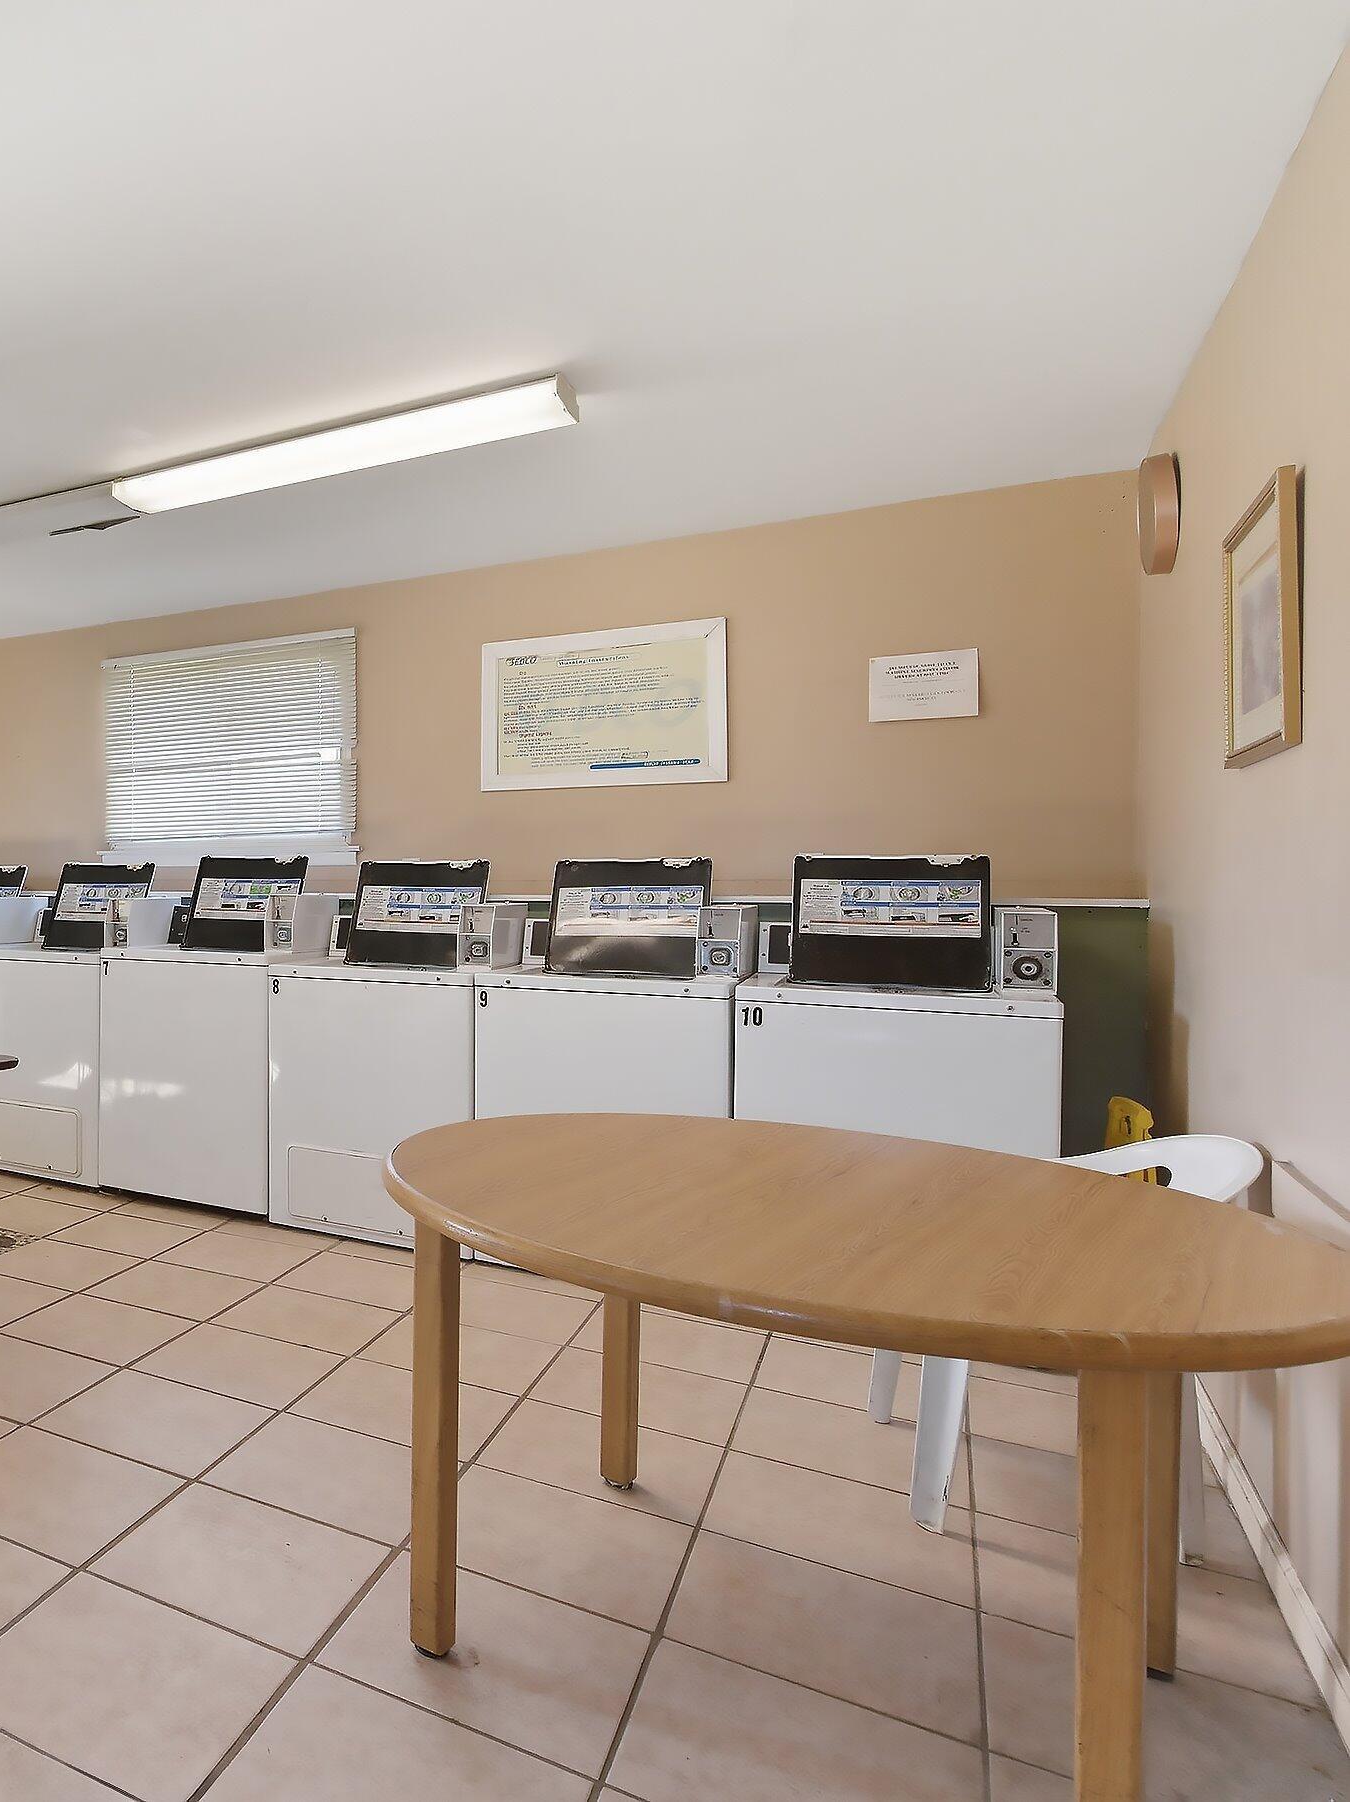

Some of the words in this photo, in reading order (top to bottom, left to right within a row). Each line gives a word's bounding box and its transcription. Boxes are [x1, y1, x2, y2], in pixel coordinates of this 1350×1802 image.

[103, 961, 109, 975] 7
[272, 979, 279, 994] 8
[480, 991, 487, 1007] 9
[742, 1006, 763, 1026] 10
